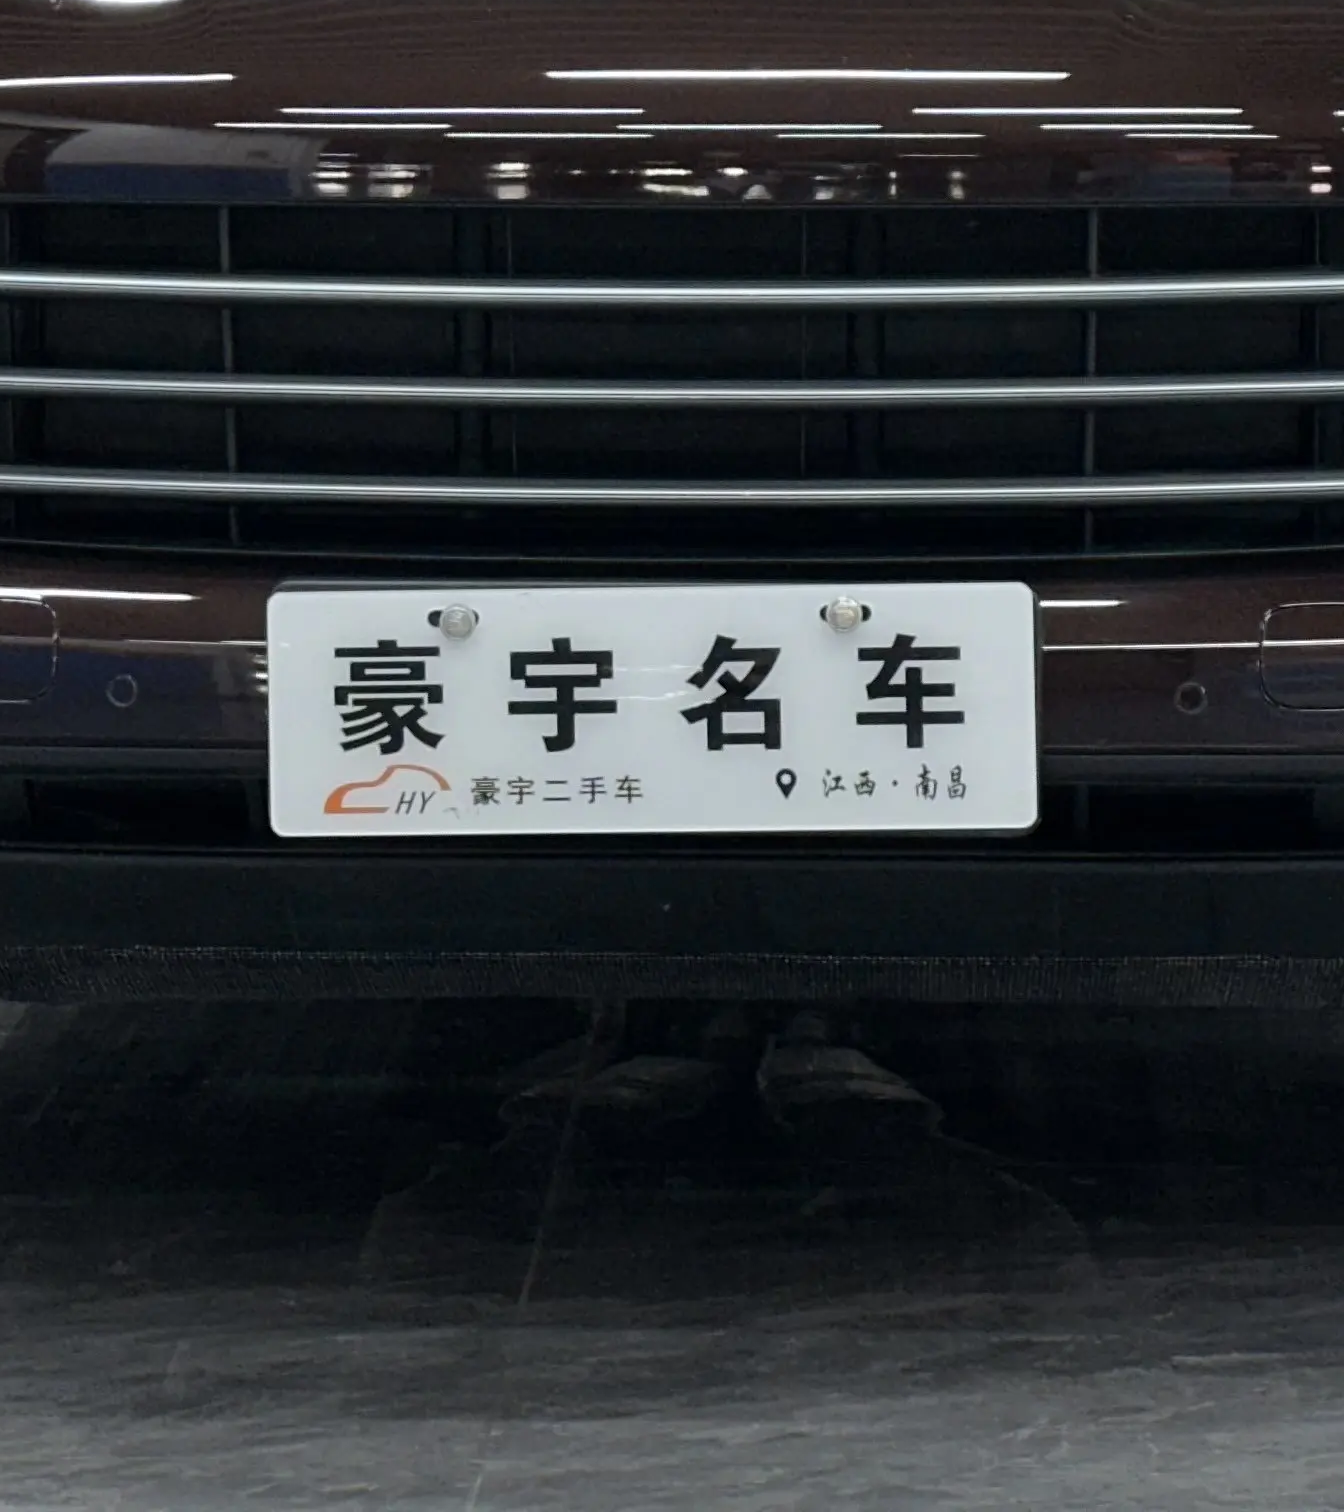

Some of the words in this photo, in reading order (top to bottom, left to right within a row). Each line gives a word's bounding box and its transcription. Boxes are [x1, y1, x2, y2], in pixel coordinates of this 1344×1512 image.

[332, 634, 967, 755] 豪宇名车
[394, 790, 437, 816] HY
[469, 774, 644, 806] 豪宇二手车
